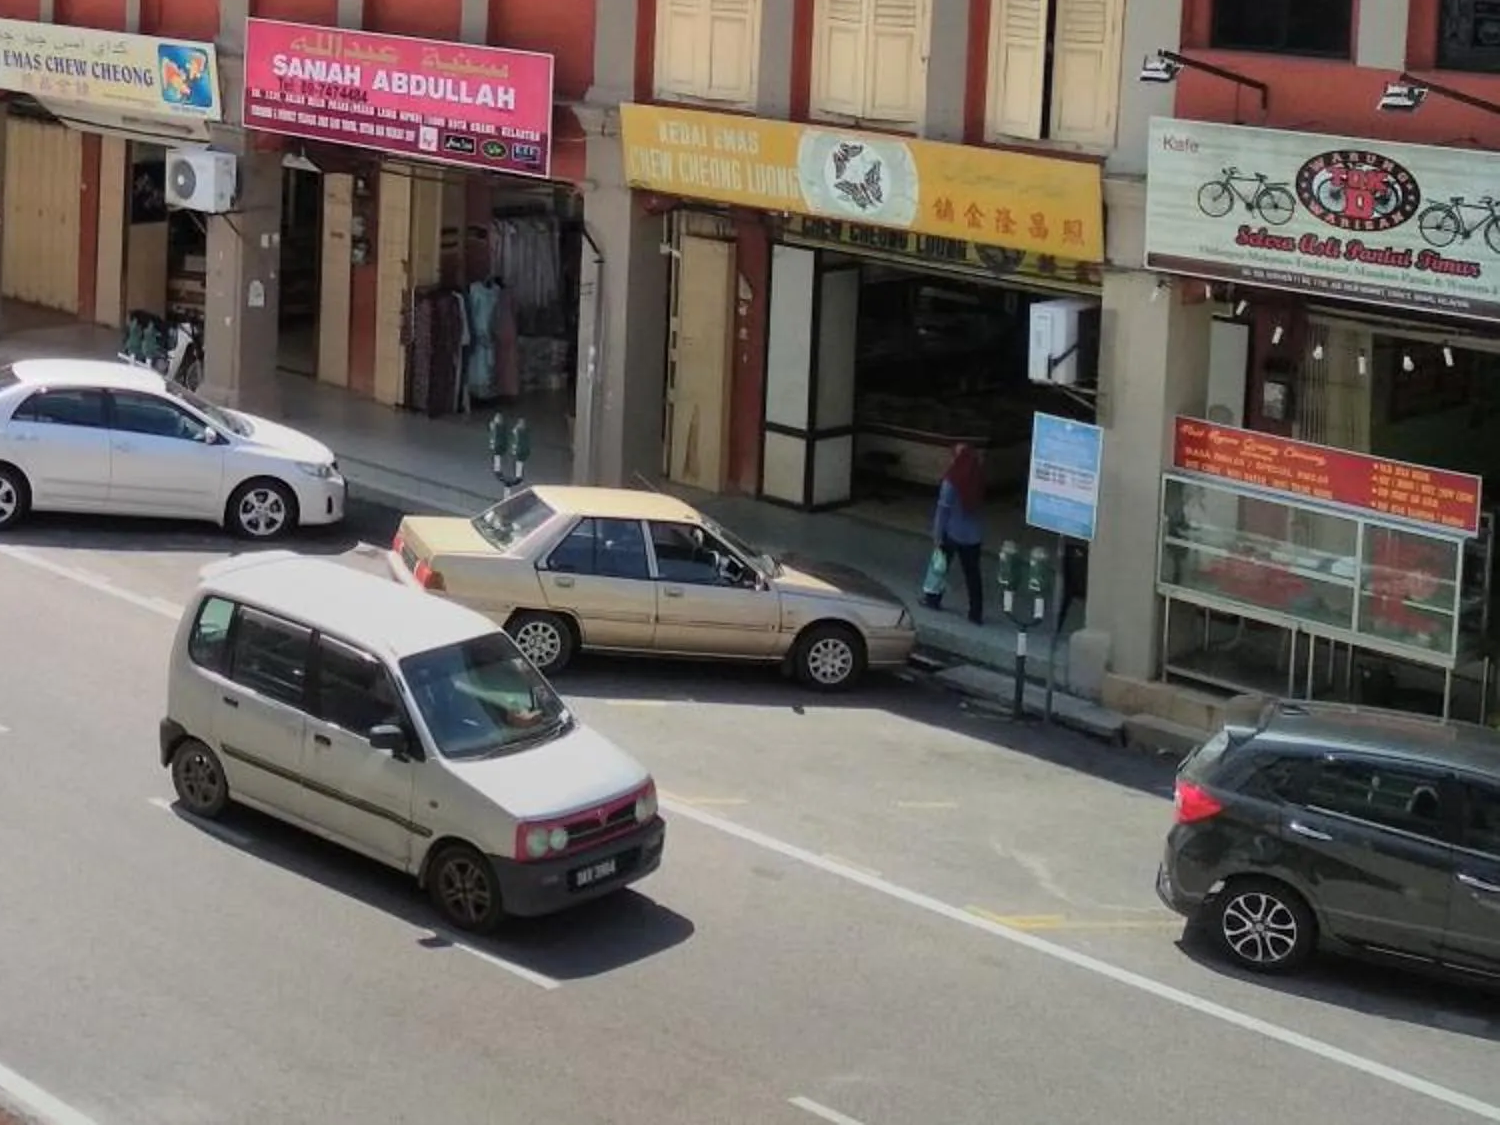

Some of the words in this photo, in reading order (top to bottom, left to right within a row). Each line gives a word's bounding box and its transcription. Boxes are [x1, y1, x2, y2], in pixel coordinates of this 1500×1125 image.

[3, 50, 43, 71] EMAS
[45, 56, 87, 76] CHEW
[91, 62, 153, 87] CHEONG
[372, 70, 516, 110] ABDULLAH
[658, 120, 708, 147] KEDAI
[713, 128, 759, 154] EMAS
[1162, 135, 1200, 152] Kafe
[678, 151, 742, 191] CHEONG
[1310, 200, 1404, 230] WARISAN
[1344, 238, 1413, 269] Pantai
[1415, 249, 1481, 278] Timur
